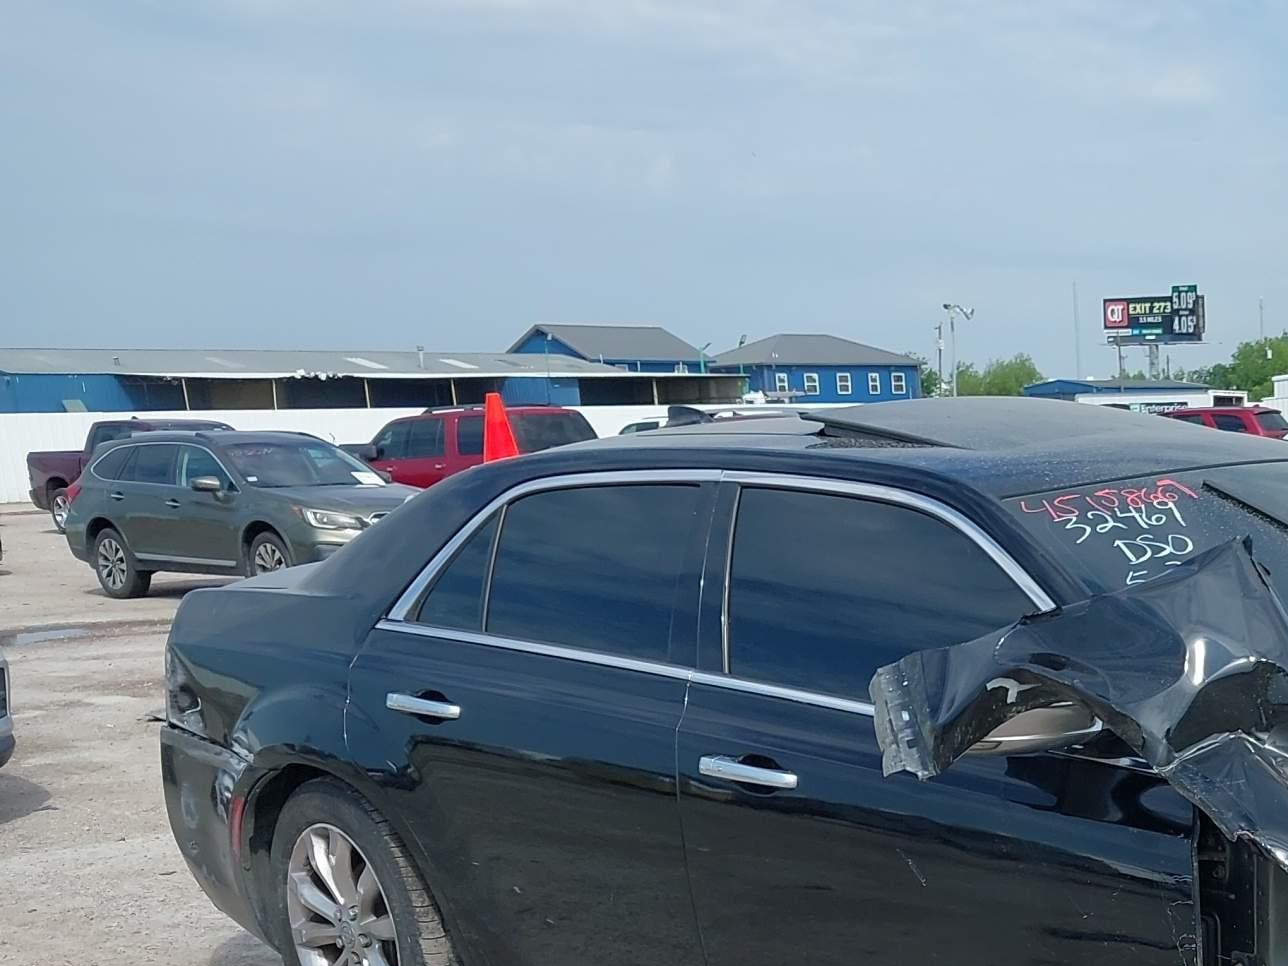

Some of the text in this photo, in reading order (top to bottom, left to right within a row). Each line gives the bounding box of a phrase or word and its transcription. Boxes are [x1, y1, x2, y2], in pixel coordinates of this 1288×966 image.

[1107, 304, 1124, 322] QT
[1129, 303, 1151, 315] EXIT
[1152, 301, 1172, 313] 273
[1053, 500, 1187, 544] 32469
